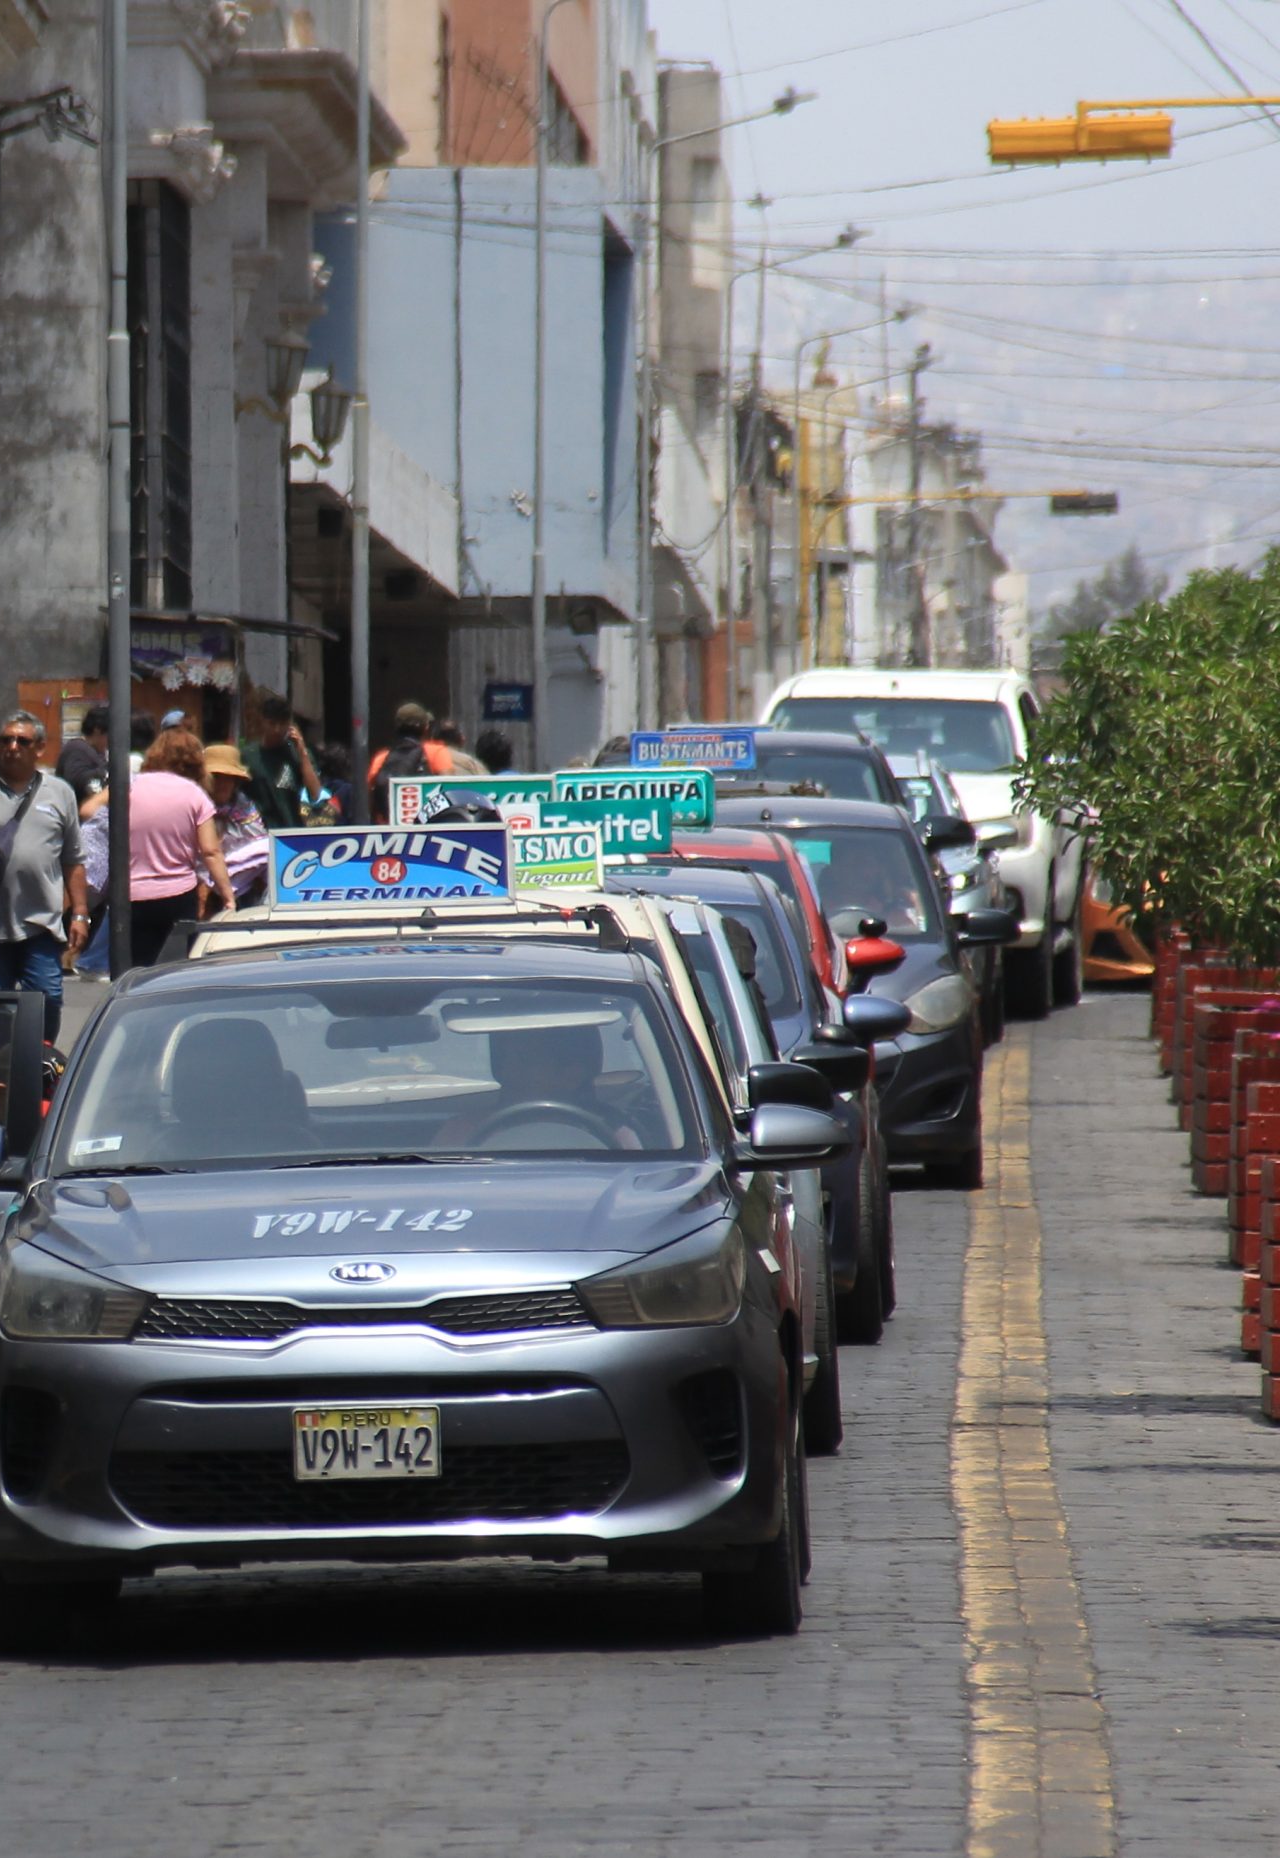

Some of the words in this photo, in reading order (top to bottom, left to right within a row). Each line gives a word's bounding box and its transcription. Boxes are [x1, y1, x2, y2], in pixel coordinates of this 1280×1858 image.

[638, 741, 748, 761] BUSTAMANTE
[544, 809, 663, 842] Txitel
[281, 832, 502, 889] COMITE
[377, 861, 401, 882] 84
[298, 884, 492, 902] TERMINAL
[252, 1209, 473, 1238] V9W-142
[340, 1263, 386, 1280] KIA
[341, 1412, 391, 1426] PERU
[300, 1427, 434, 1470] V9W-142
